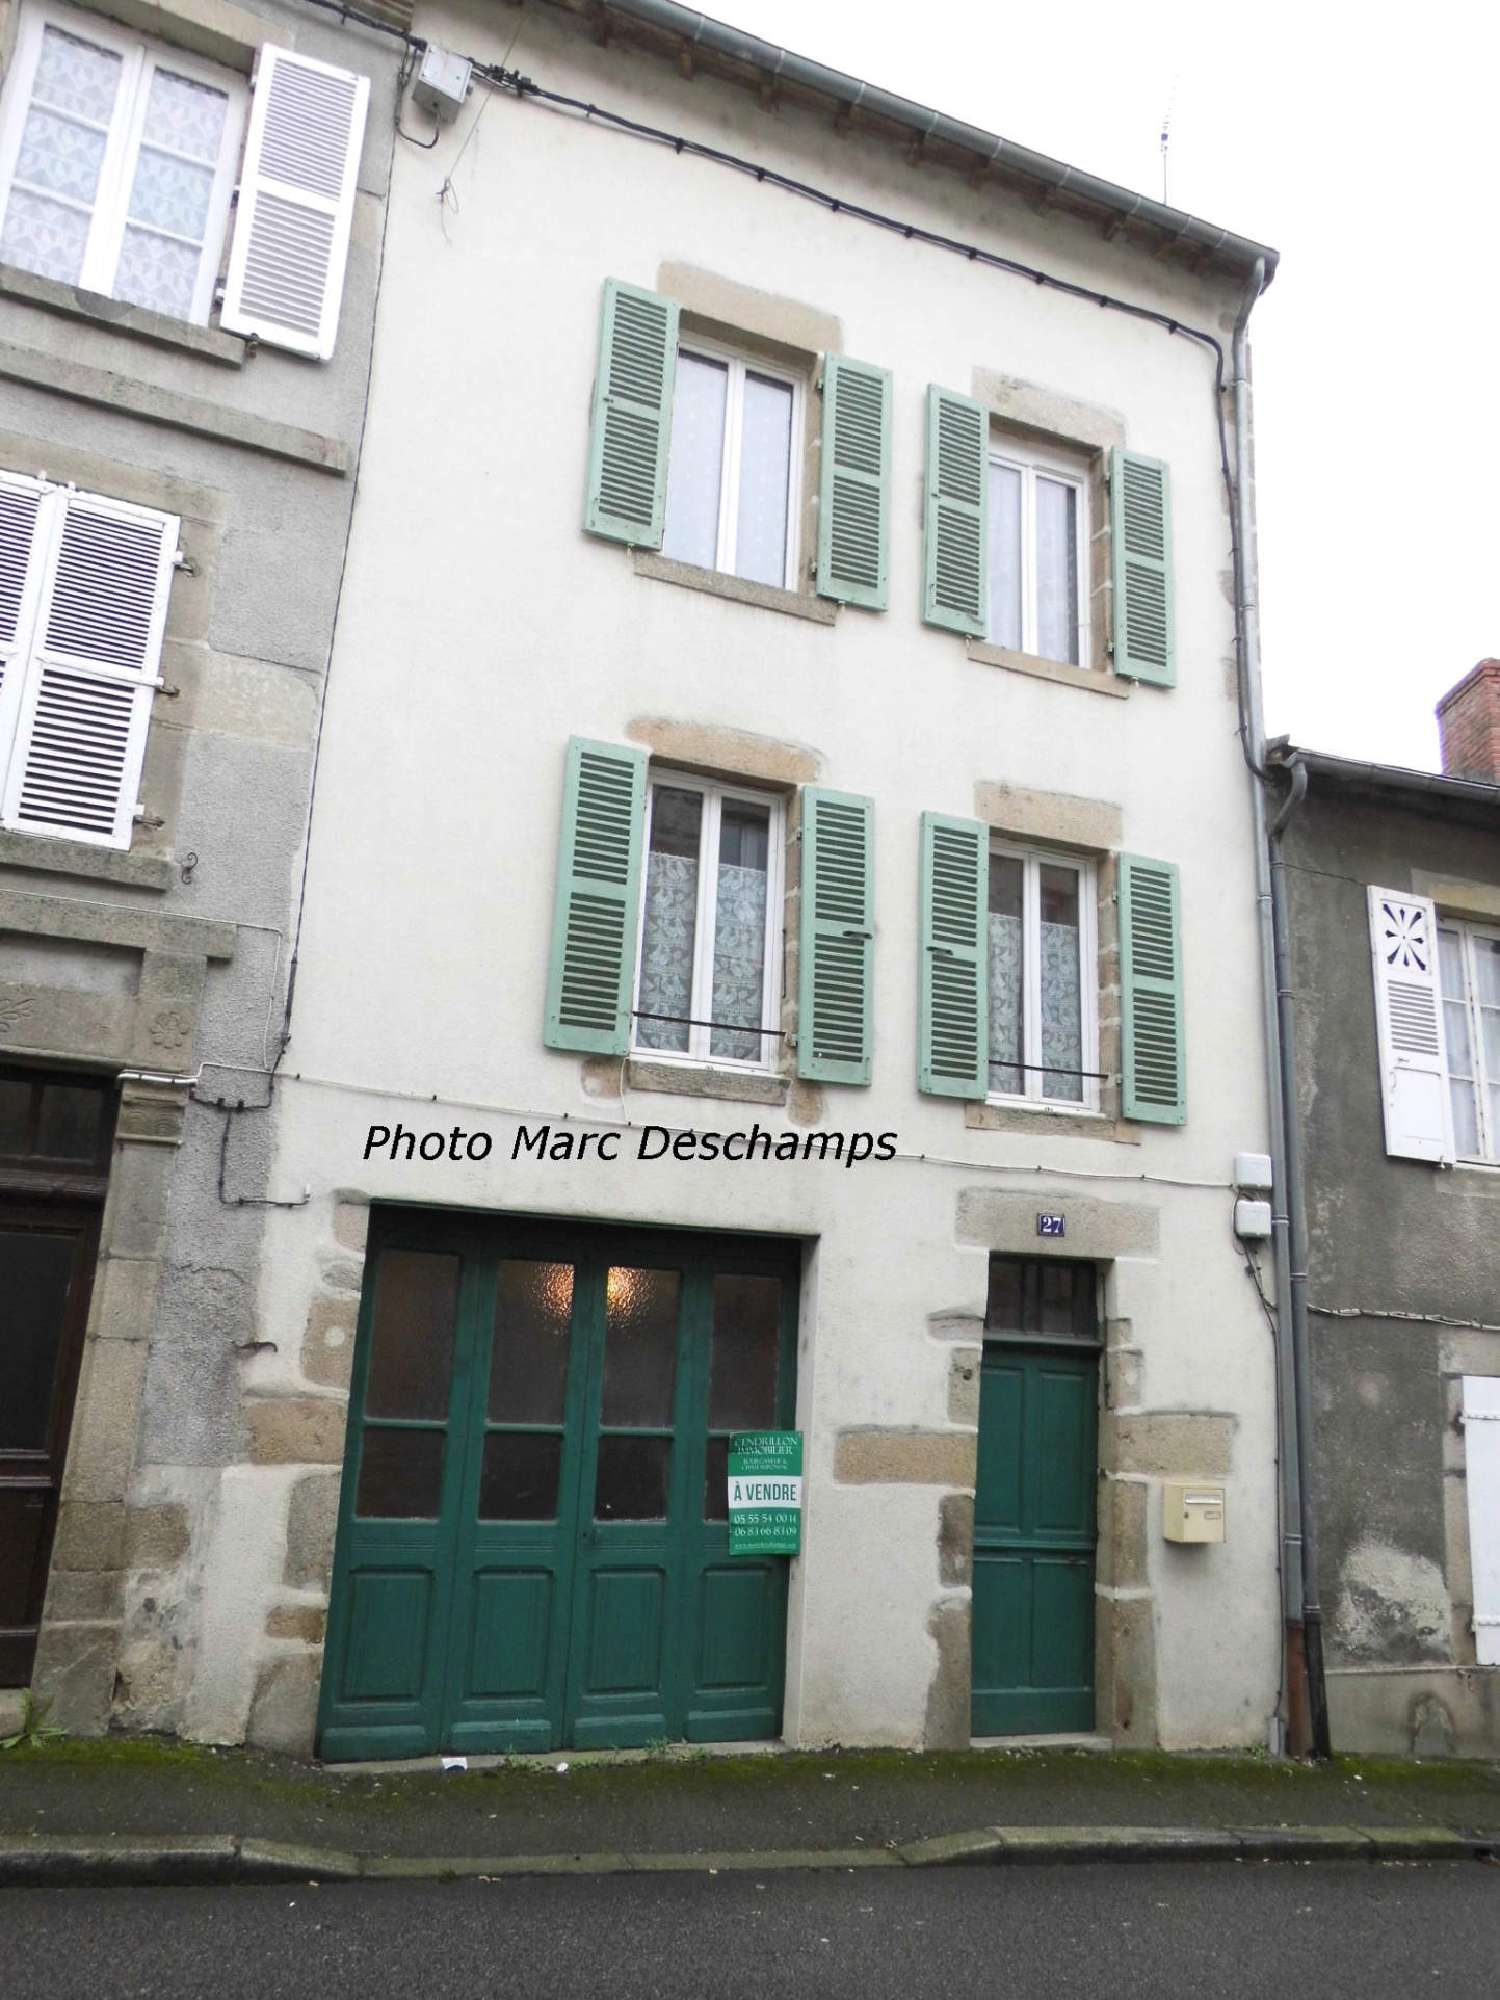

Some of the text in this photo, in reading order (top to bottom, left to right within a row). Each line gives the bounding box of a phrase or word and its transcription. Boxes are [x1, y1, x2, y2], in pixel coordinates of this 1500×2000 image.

[1042, 1216, 1062, 1233] 27
[734, 1480, 797, 1501] À VENDRE
[734, 1514, 746, 1525] 05
[748, 1513, 760, 1524] 55
